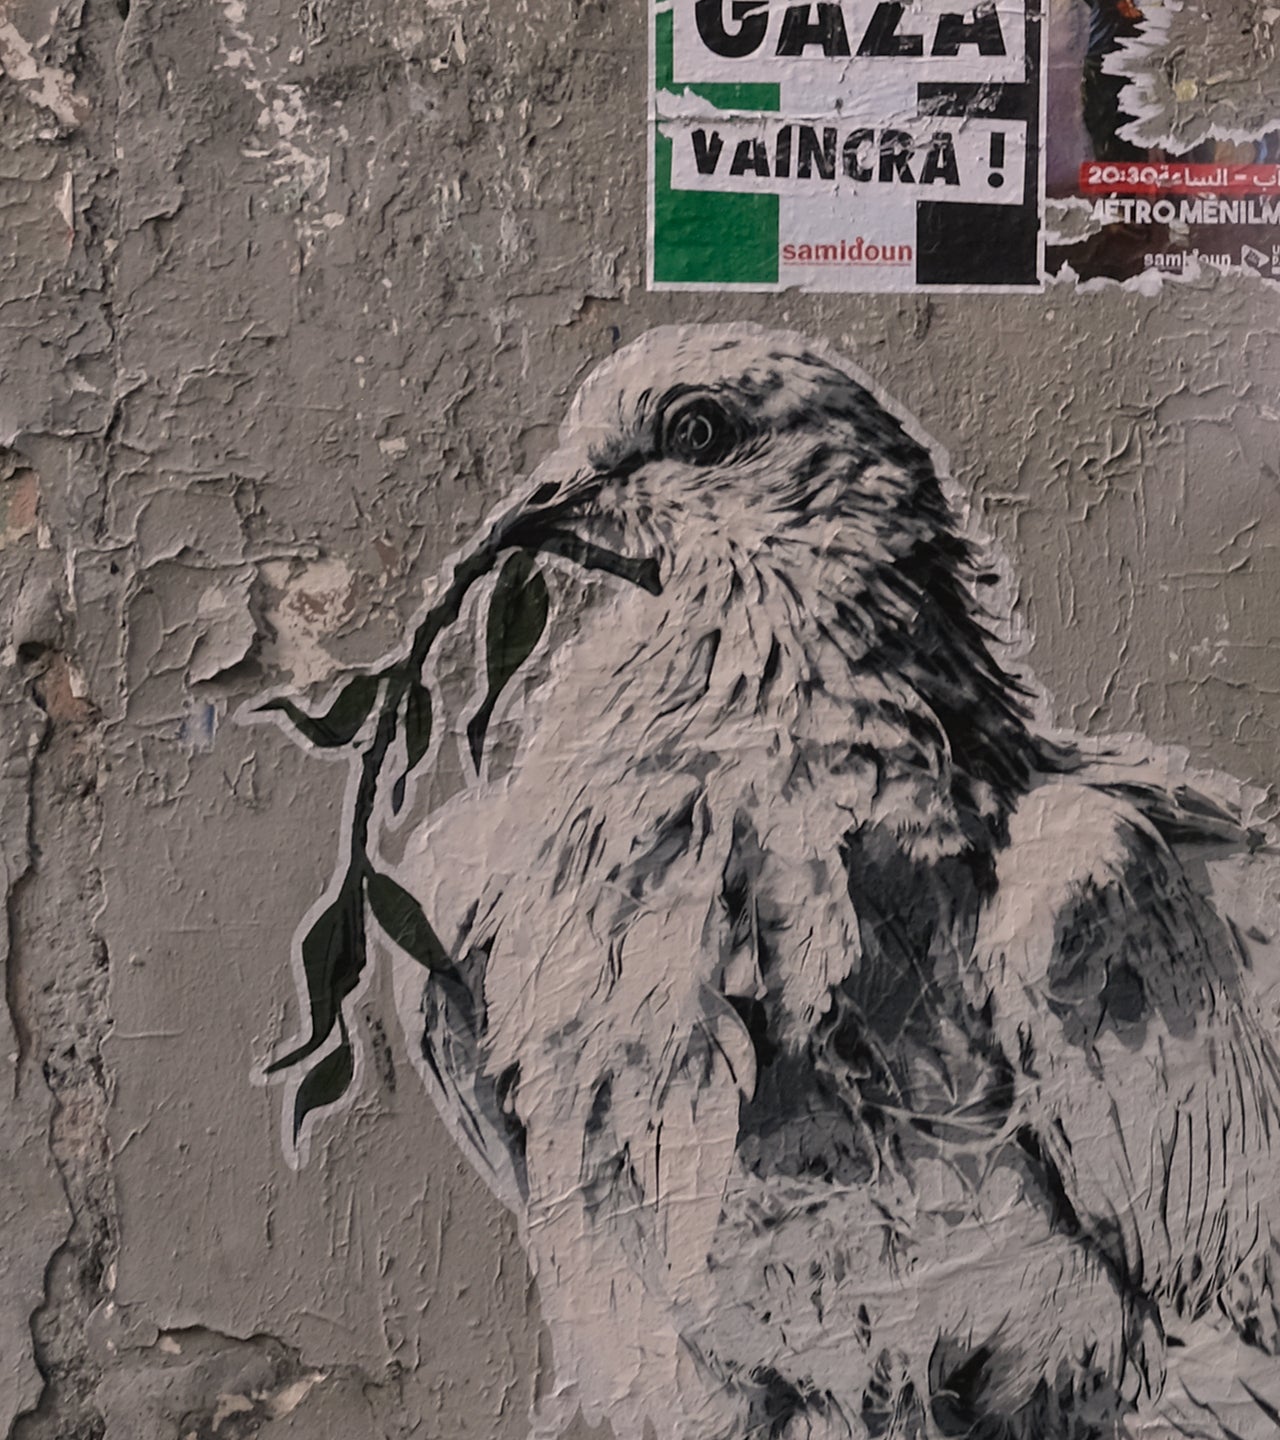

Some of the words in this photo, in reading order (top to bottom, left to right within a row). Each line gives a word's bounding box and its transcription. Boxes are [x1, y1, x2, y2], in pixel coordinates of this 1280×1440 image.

[691, 126, 960, 186] VAINCRA
[988, 131, 1005, 188] !
[782, 236, 914, 263] samidoun
